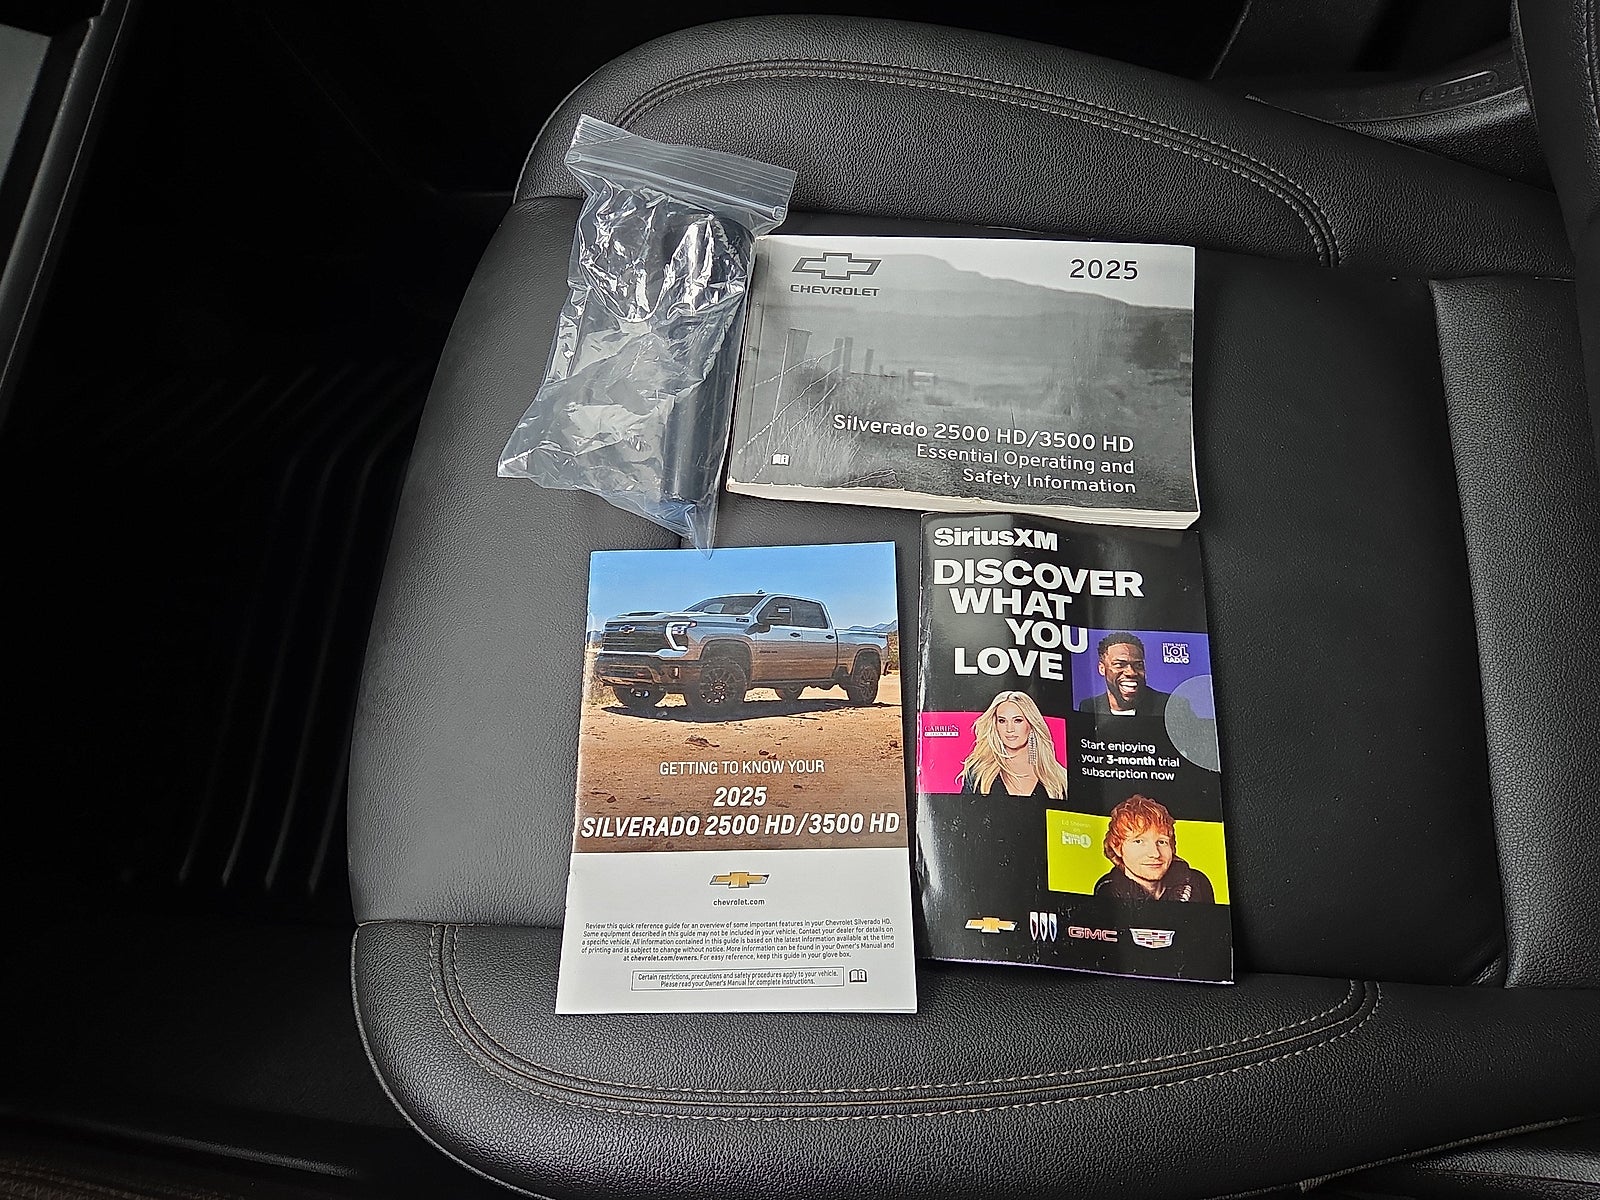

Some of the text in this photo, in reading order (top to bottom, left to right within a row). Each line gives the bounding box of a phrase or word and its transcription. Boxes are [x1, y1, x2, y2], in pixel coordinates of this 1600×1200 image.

[1069, 258, 1139, 281] 2025
[790, 284, 880, 297] CHEVROLET
[833, 414, 1134, 452] Silverado 2500 HD/3500 HD
[917, 444, 1134, 474] Essential Operating and
[963, 468, 1136, 493] Safety Information
[933, 527, 1058, 551] SiriusXM
[933, 558, 1144, 597] DISCOVER
[948, 587, 1072, 621] WHAT
[1005, 618, 1089, 654] YOU
[954, 647, 1063, 680] LOVE
[1163, 646, 1189, 658] LOL
[1081, 739, 1155, 754] Start enjoying
[660, 759, 825, 776] GETTING TO KNOW YOUR
[1081, 754, 1179, 767] your 3-month trial
[1082, 767, 1175, 780] subscription now
[713, 786, 767, 807] 2025
[581, 812, 900, 838] SILVERADO 2500 HD/3500 HD
[1068, 926, 1118, 942] GMC
